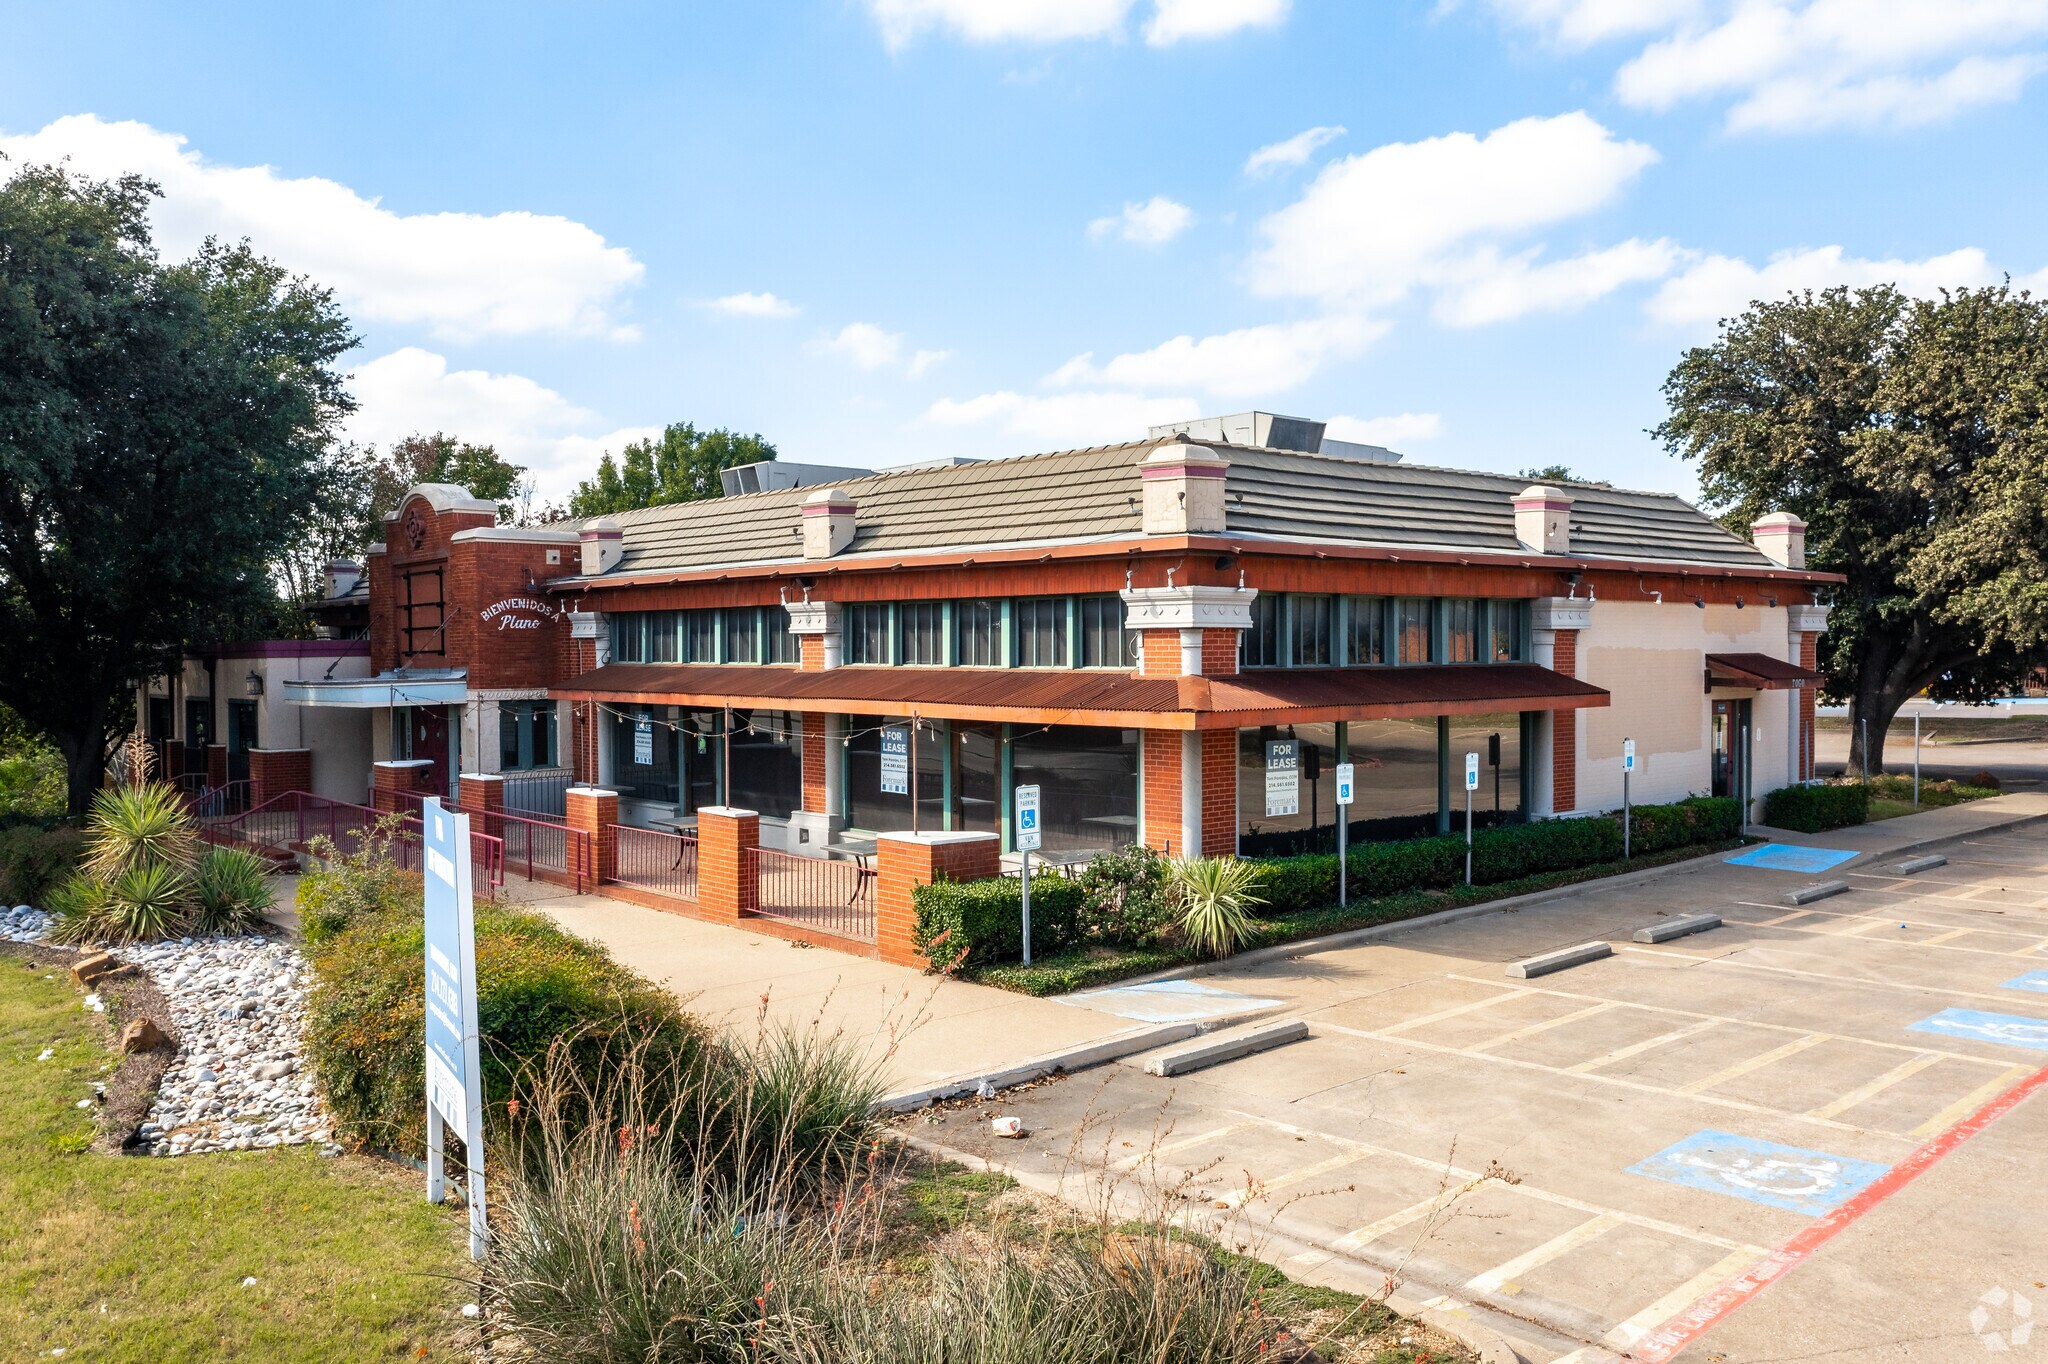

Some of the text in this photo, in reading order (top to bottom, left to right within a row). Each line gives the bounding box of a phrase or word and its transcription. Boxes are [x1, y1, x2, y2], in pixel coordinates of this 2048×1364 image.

[480, 598, 560, 623] BIENVENIDOS A
[497, 614, 542, 631] Plano
[886, 731, 902, 741] FOR
[882, 743, 906, 753] LEASE
[1273, 745, 1292, 755] FOR
[1268, 758, 1296, 769] LEASE
